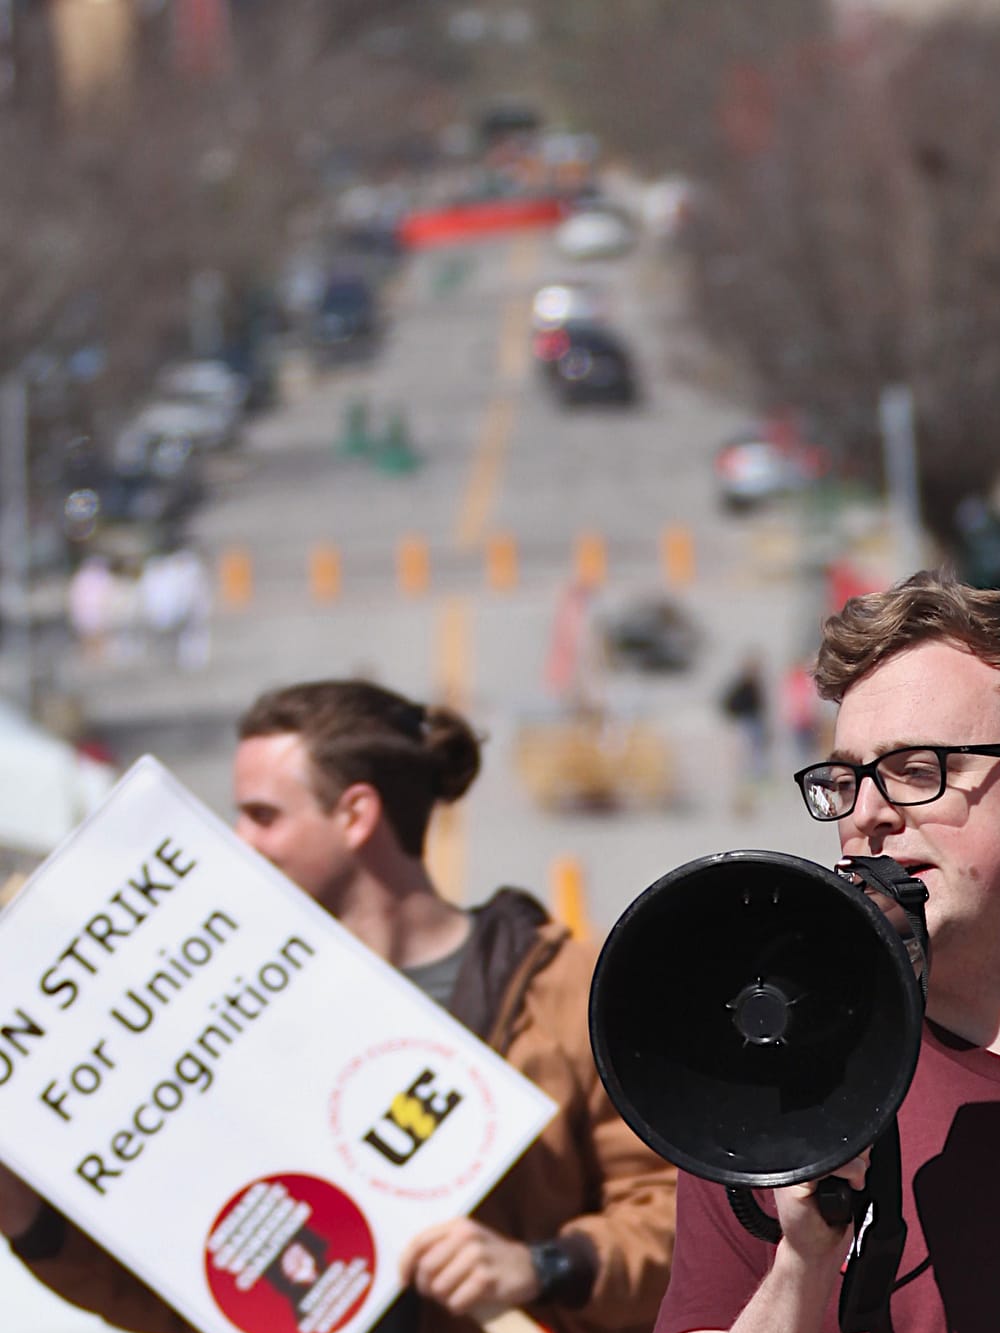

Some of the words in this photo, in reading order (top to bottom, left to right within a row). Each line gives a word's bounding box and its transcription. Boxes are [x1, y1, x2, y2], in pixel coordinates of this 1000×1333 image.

[39, 1039, 116, 1123] For
[110, 909, 239, 1034] Union
[40, 837, 198, 1010] STRIKE
[74, 935, 316, 1196] Recognition
